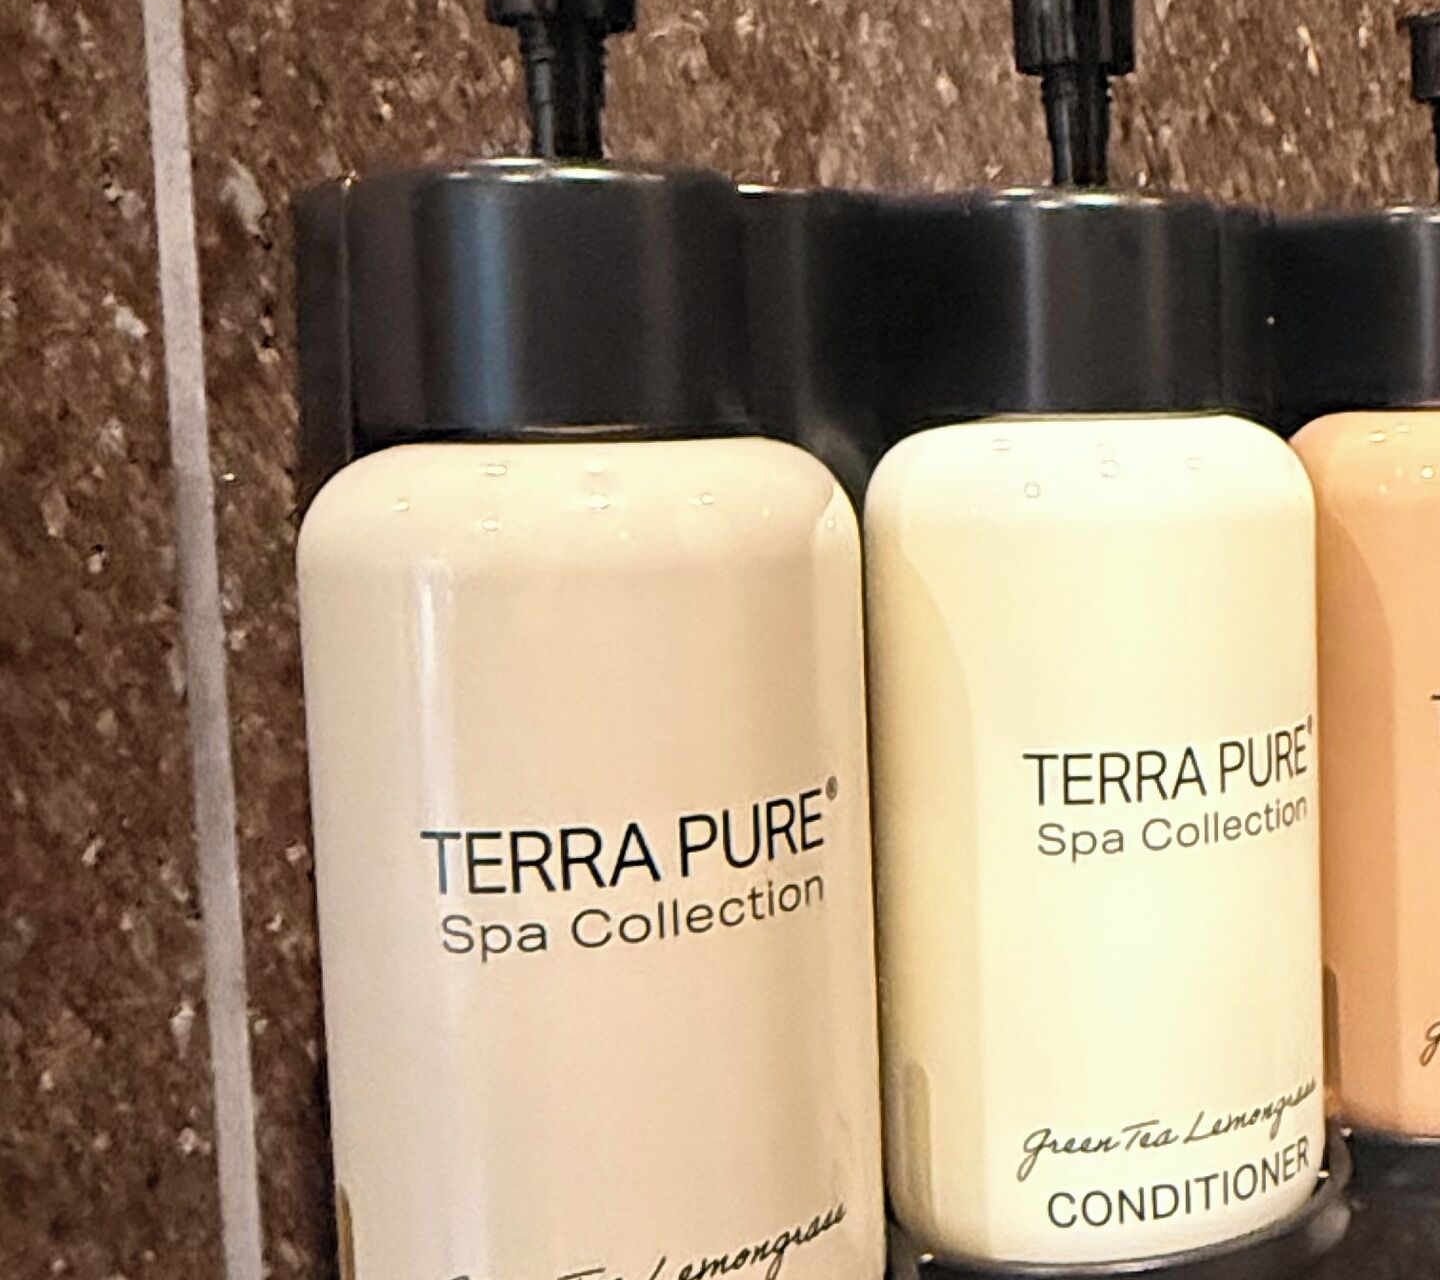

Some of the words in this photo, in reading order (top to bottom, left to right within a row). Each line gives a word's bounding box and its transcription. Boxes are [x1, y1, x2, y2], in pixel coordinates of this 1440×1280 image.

[1022, 746, 1207, 806] TERRA
[420, 822, 661, 895] TERRA
[1037, 822, 1125, 864] Spa
[1141, 795, 1307, 851] Collection
[441, 914, 548, 964] Spa
[571, 875, 825, 949] Collection
[1016, 1127, 1121, 1183] Green
[1121, 1120, 1179, 1151] Tea
[1047, 1135, 1310, 1229] CONDITIONER
